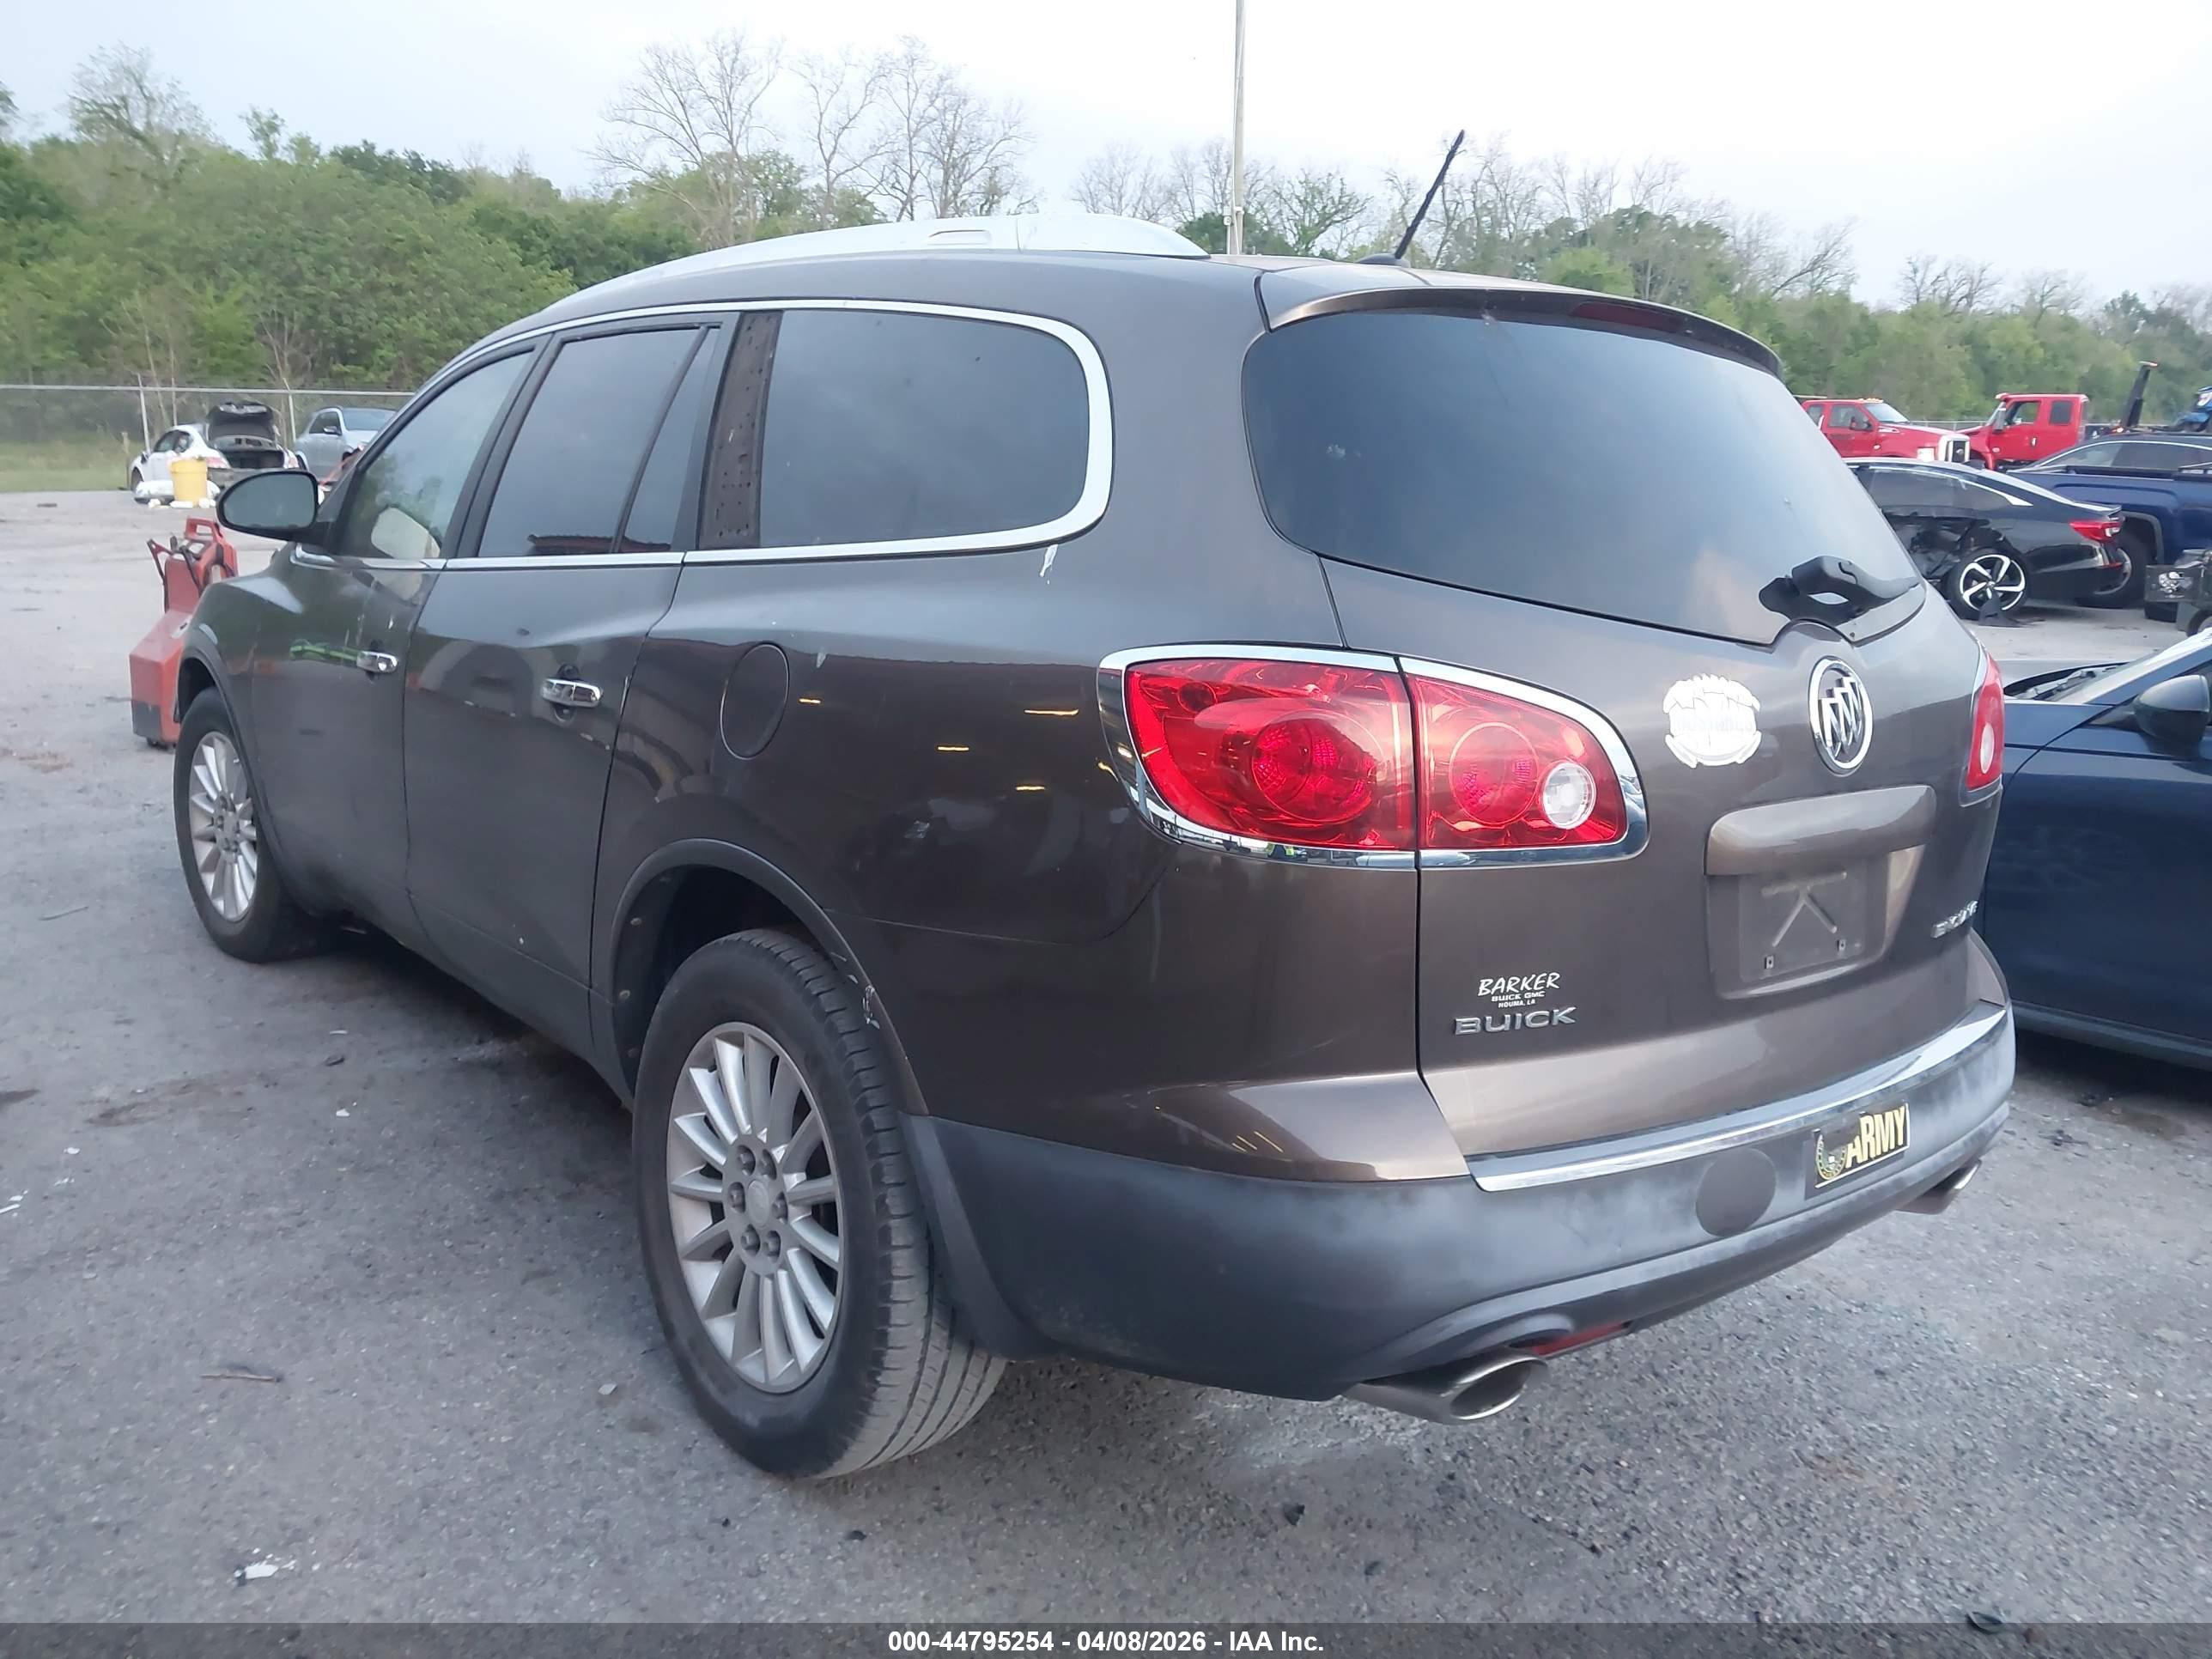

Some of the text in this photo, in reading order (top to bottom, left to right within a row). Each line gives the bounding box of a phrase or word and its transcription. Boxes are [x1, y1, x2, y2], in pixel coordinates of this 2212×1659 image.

[1478, 972, 1560, 996] BARKER
[1492, 994, 1521, 1002] BUICK
[1455, 1006, 1577, 1036] BUICK
[1845, 1106, 1905, 1169] ARMY
